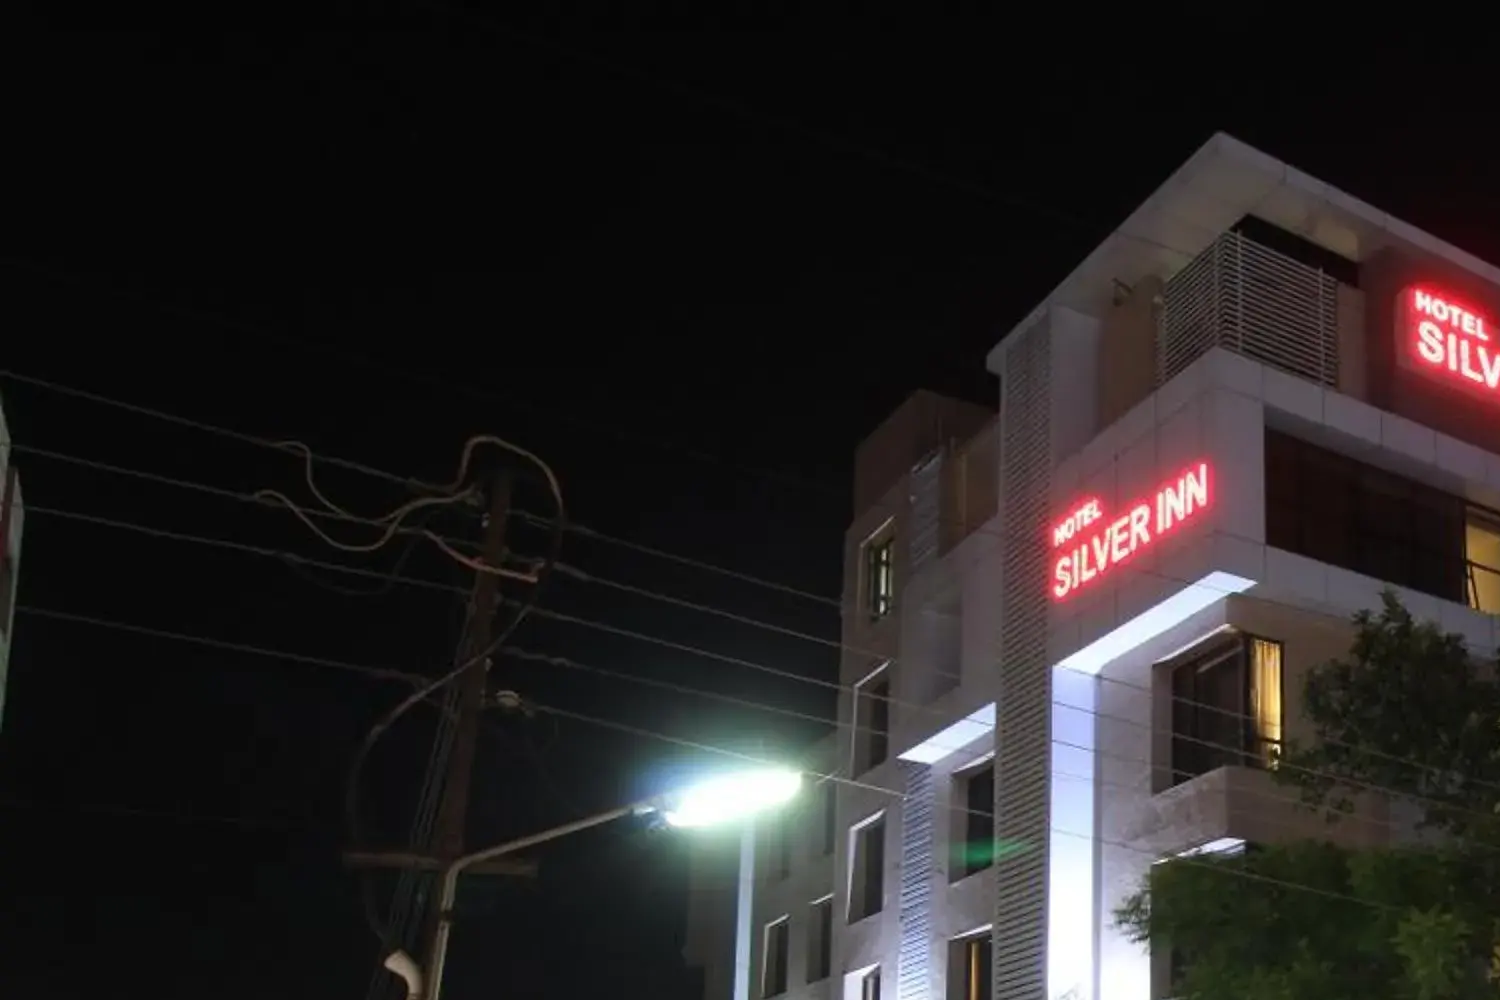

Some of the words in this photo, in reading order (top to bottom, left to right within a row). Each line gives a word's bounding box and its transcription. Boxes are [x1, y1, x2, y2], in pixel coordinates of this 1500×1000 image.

[1414, 288, 1489, 341] HOTEL
[1053, 499, 1102, 548] HOTEL
[1053, 503, 1151, 598] SILVER
[1156, 463, 1208, 535] INN
